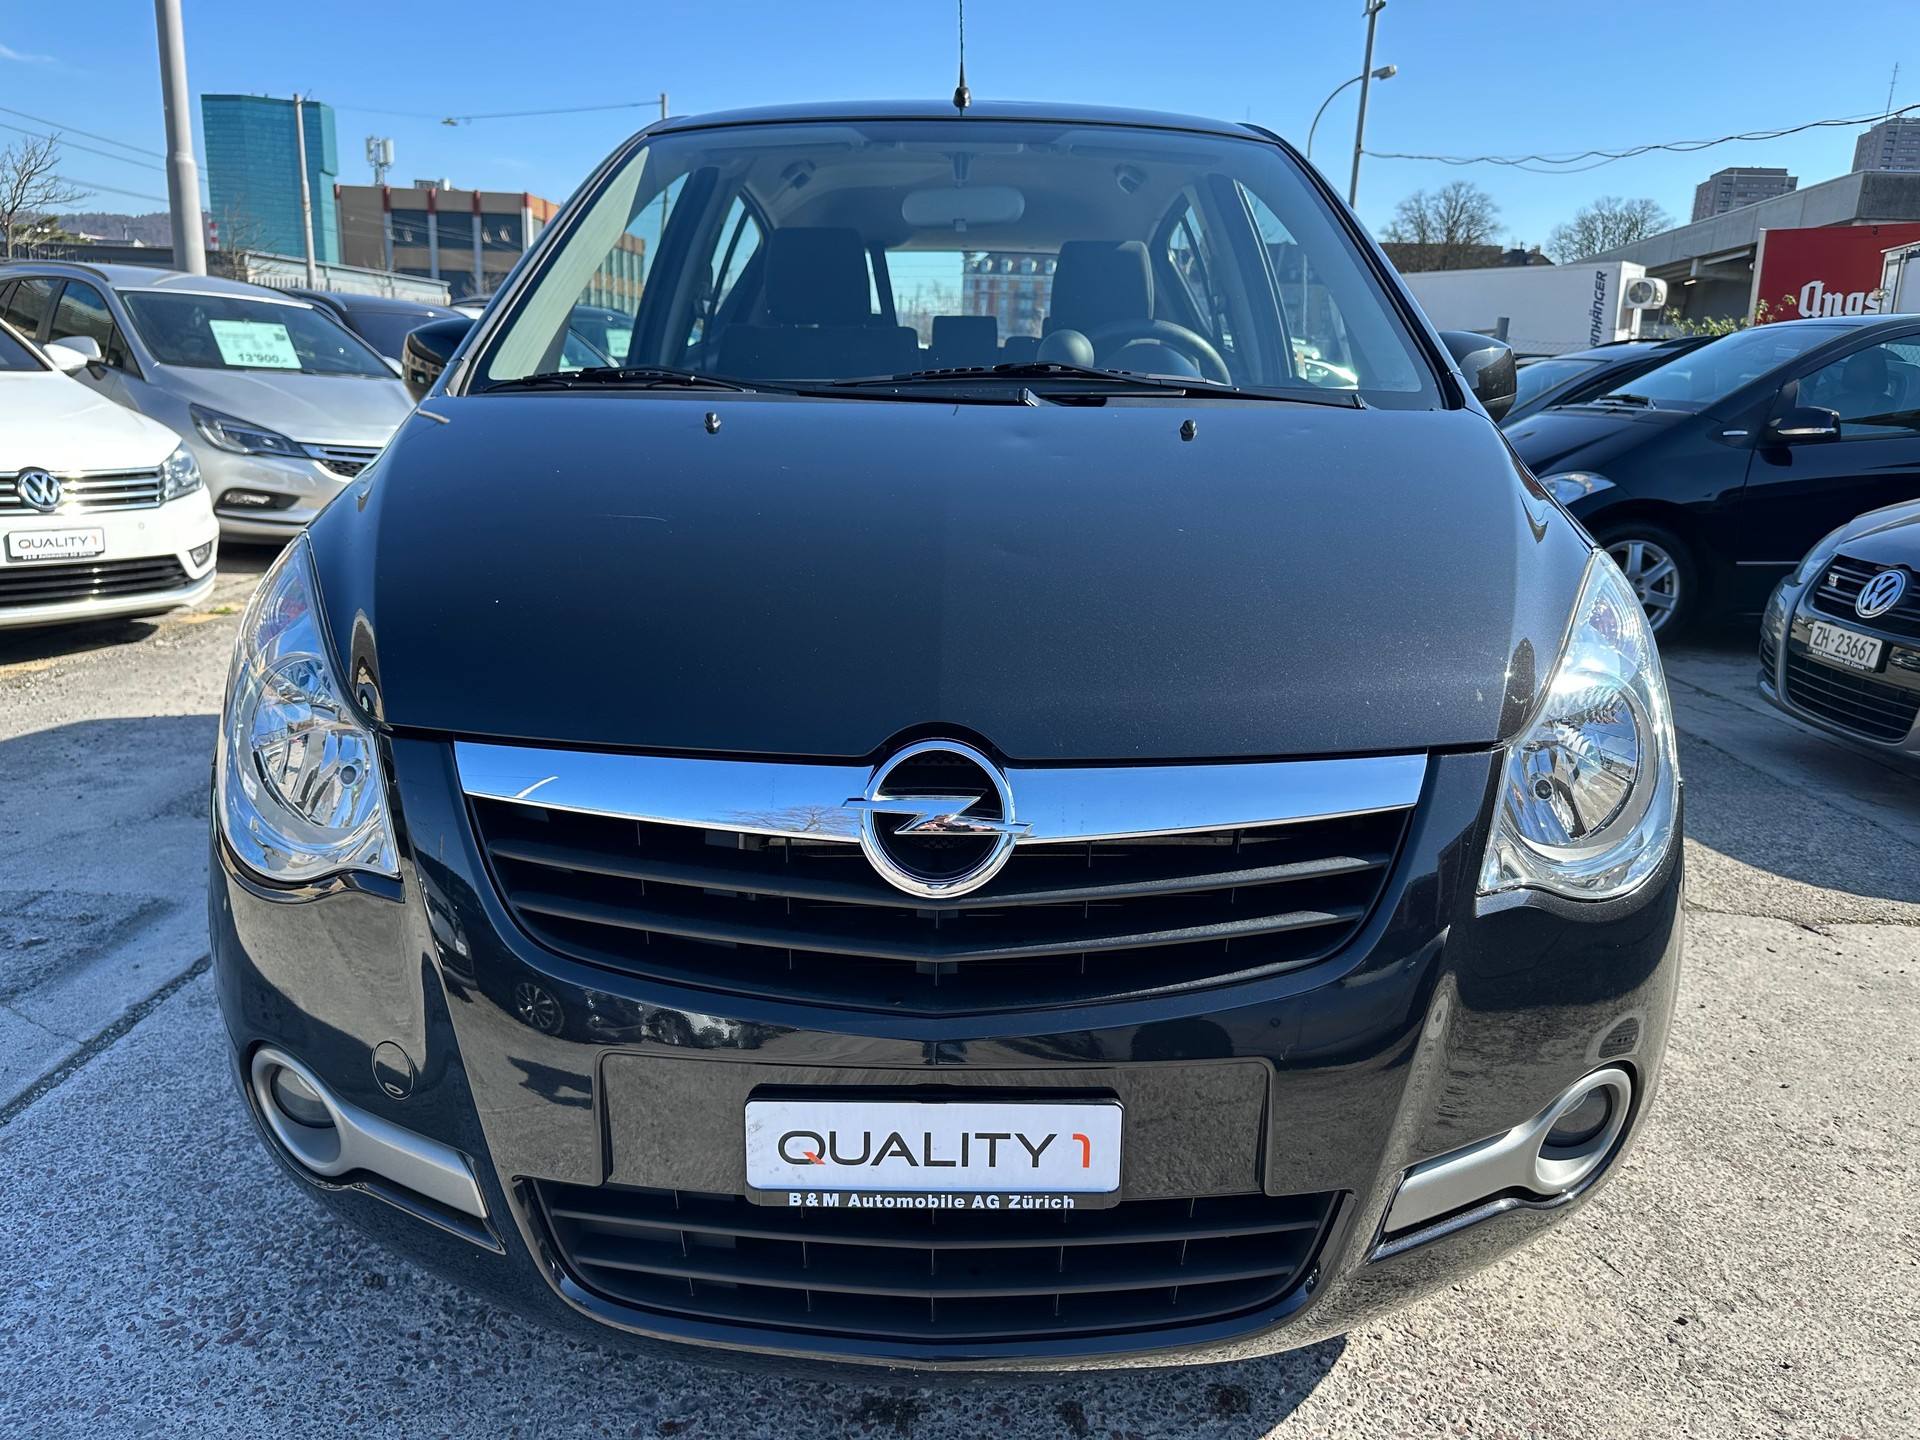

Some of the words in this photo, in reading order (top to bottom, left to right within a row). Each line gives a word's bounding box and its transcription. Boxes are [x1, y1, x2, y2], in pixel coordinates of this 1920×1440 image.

[18, 535, 88, 550] QUALITY
[777, 1130, 1058, 1169] QUALITY
[1072, 1133, 1091, 1169] 1
[848, 1193, 965, 1208] Automobile
[971, 1194, 1000, 1209] AG
[1008, 1194, 1075, 1209] Zürich
